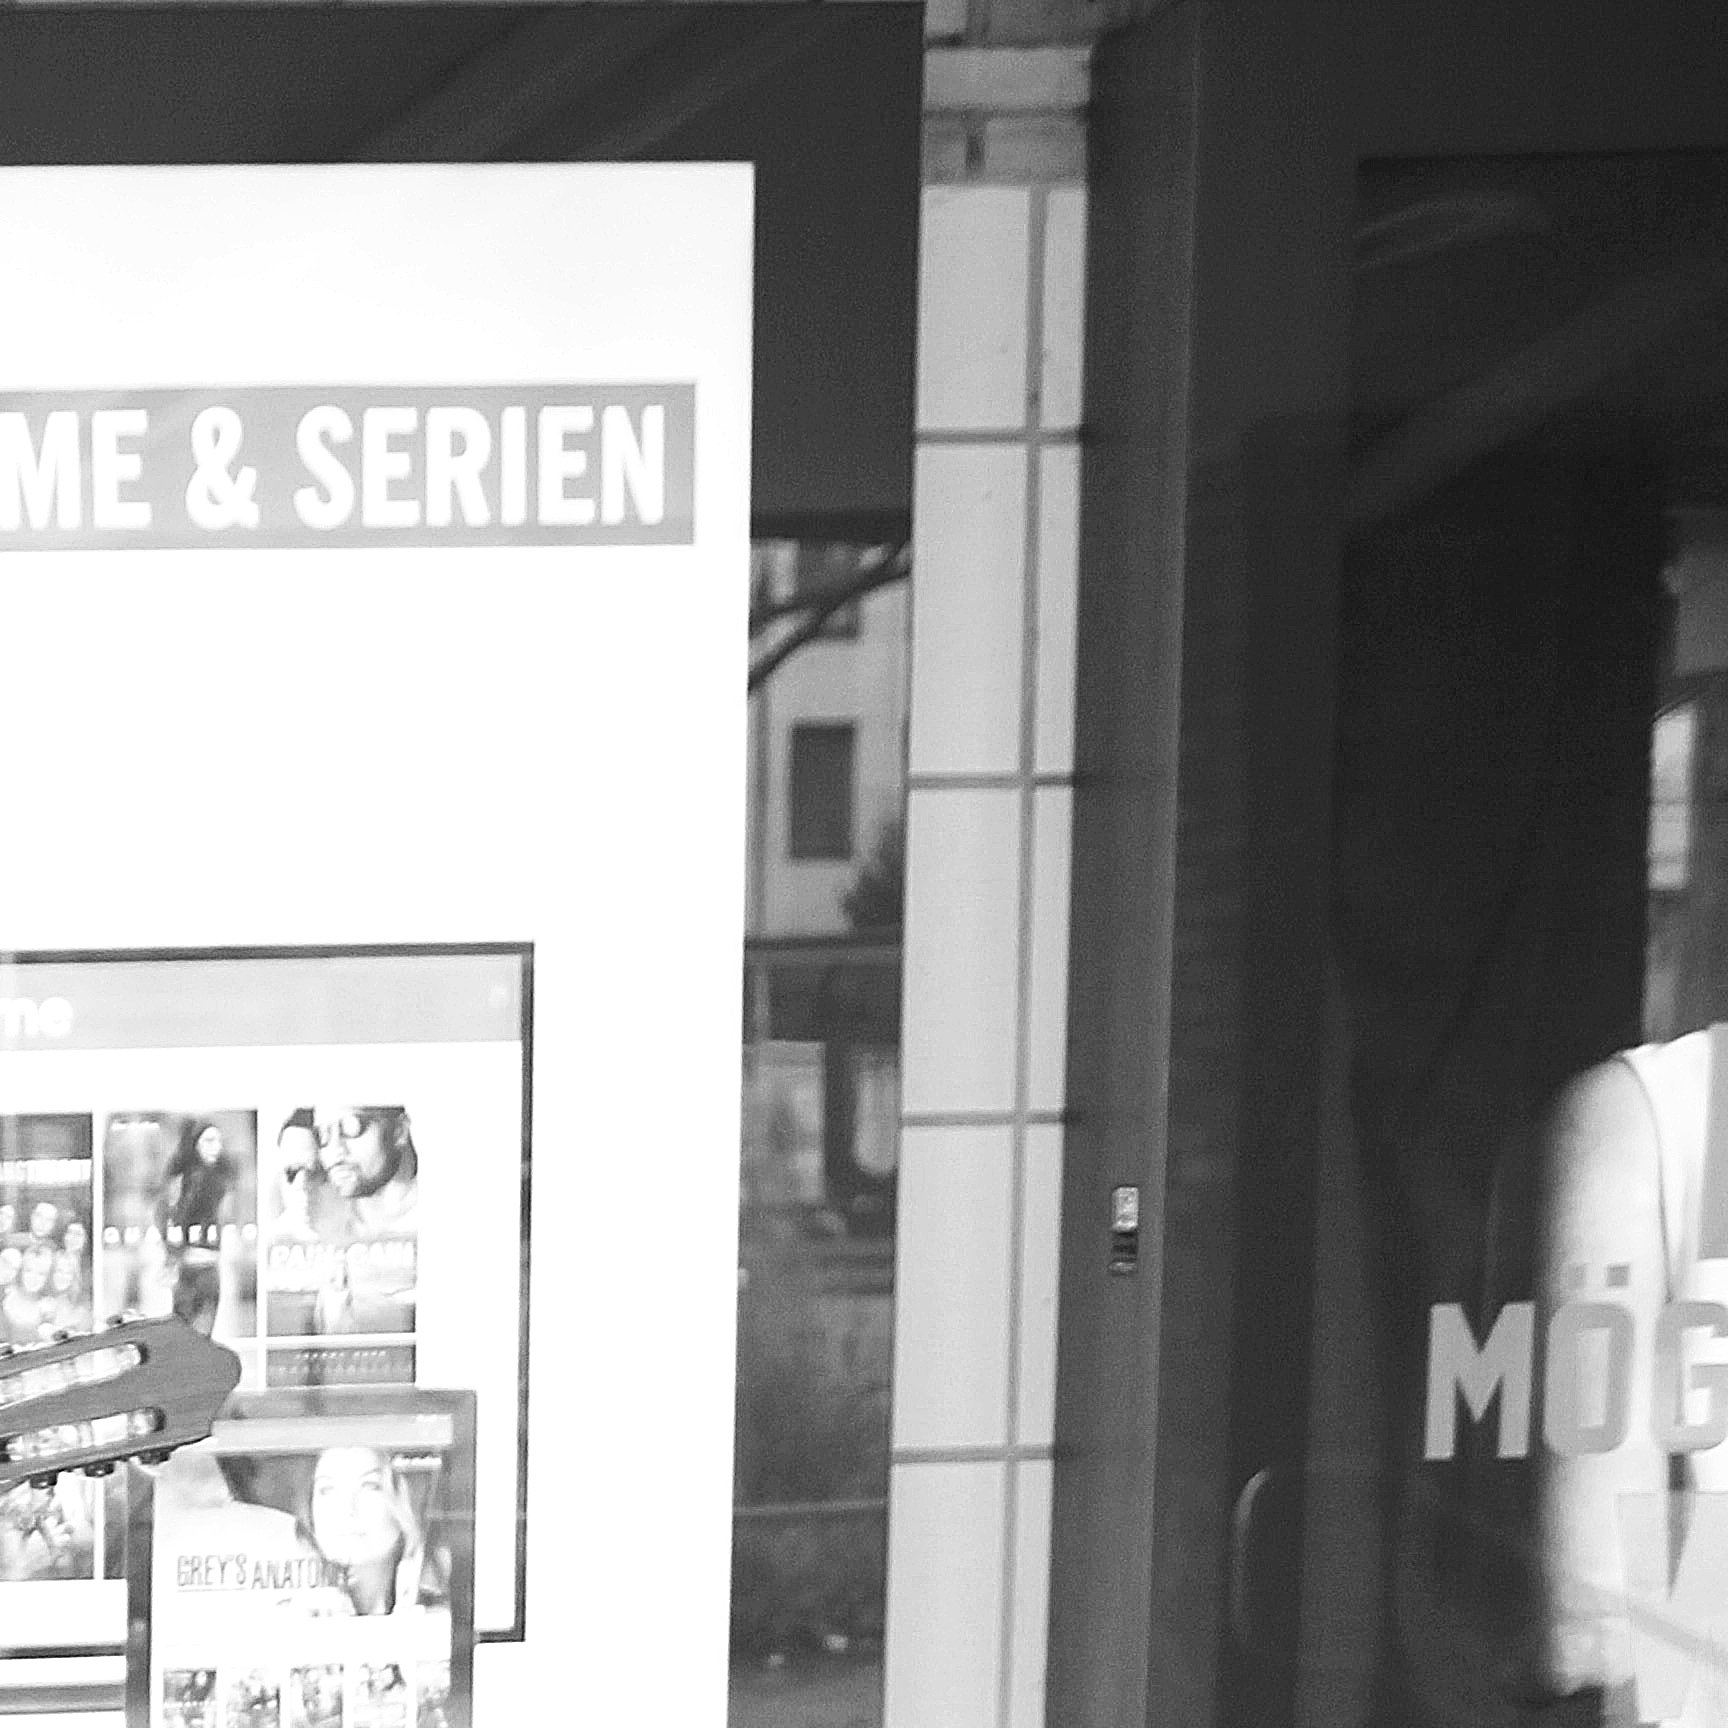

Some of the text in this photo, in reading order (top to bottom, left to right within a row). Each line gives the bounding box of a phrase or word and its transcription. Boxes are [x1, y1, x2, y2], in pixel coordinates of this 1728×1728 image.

[185, 405, 260, 532] &
[292, 403, 665, 530] SERIEN
[176, 1554, 248, 1589] GREY'S
